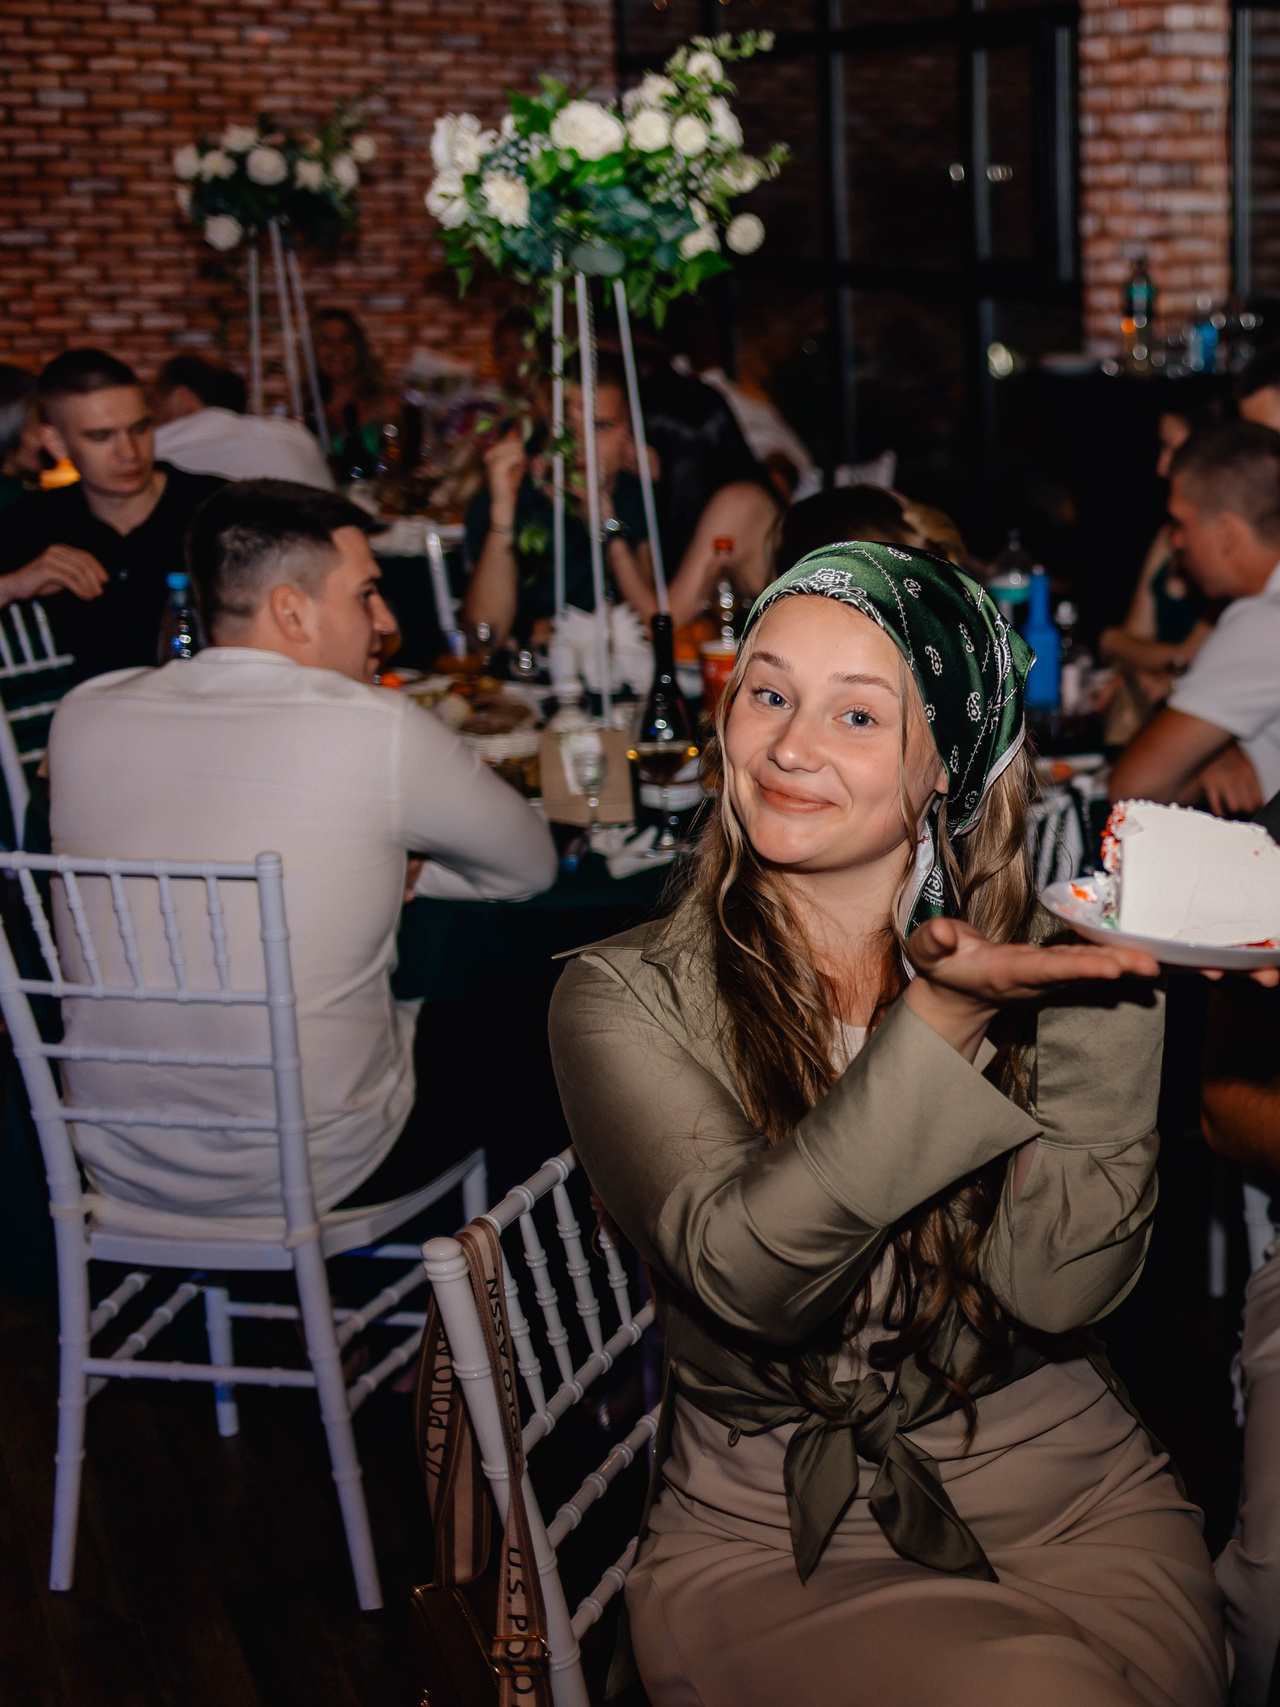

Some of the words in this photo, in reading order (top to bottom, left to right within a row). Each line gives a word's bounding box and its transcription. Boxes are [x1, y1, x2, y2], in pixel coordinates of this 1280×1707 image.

[485, 1267, 509, 1359] ASSN.
[427, 1364, 455, 1431] POLO
[507, 1546, 525, 1603] U.S.
